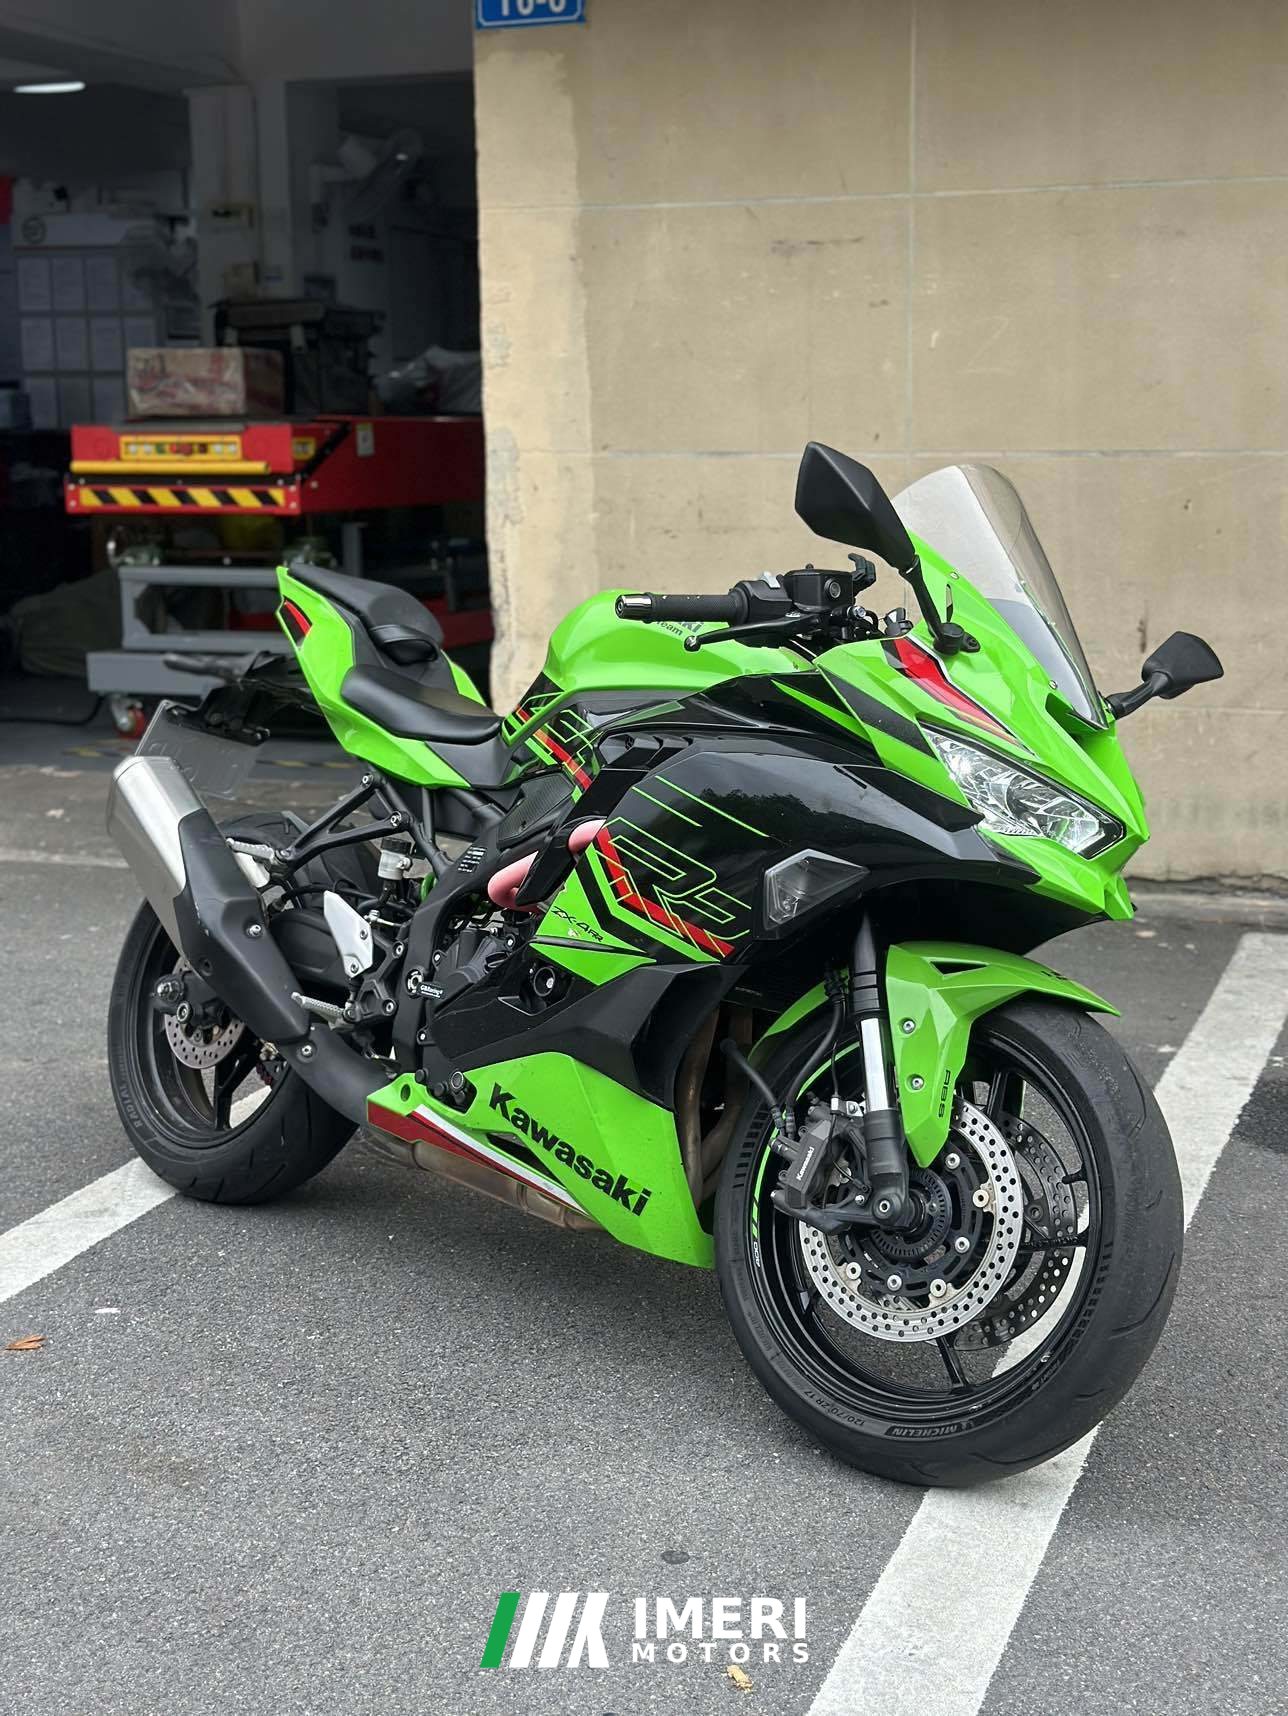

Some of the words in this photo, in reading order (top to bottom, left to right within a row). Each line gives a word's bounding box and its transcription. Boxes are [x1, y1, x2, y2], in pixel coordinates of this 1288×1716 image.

[938, 1069, 952, 1118] ABS
[488, 1081, 653, 1217] Kawasaki
[892, 1424, 958, 1437] MICHELIN
